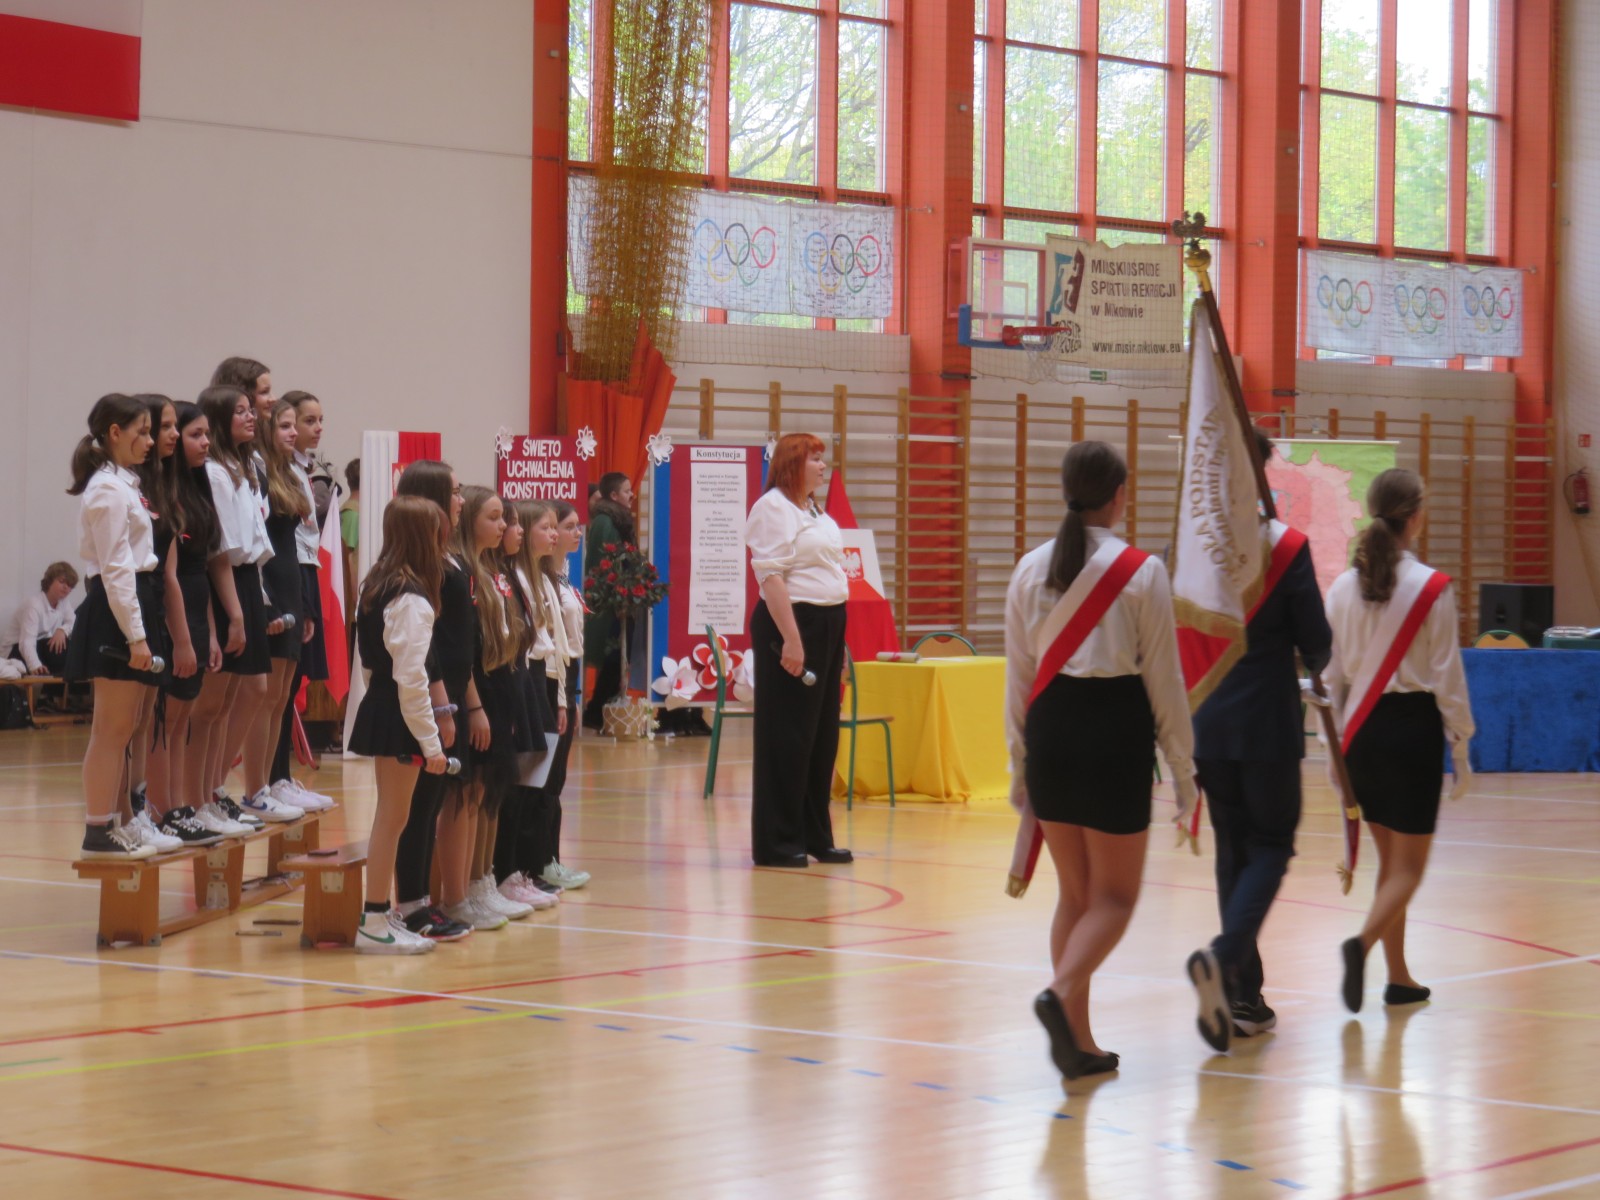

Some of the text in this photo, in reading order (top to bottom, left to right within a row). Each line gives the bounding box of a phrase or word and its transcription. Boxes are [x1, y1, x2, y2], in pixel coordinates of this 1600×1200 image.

[1091, 306, 1101, 315] w
[696, 449, 741, 461] Konstytucja
[506, 460, 575, 479] UCHWALENIA
[502, 481, 577, 500] KONSTYTUCJI
